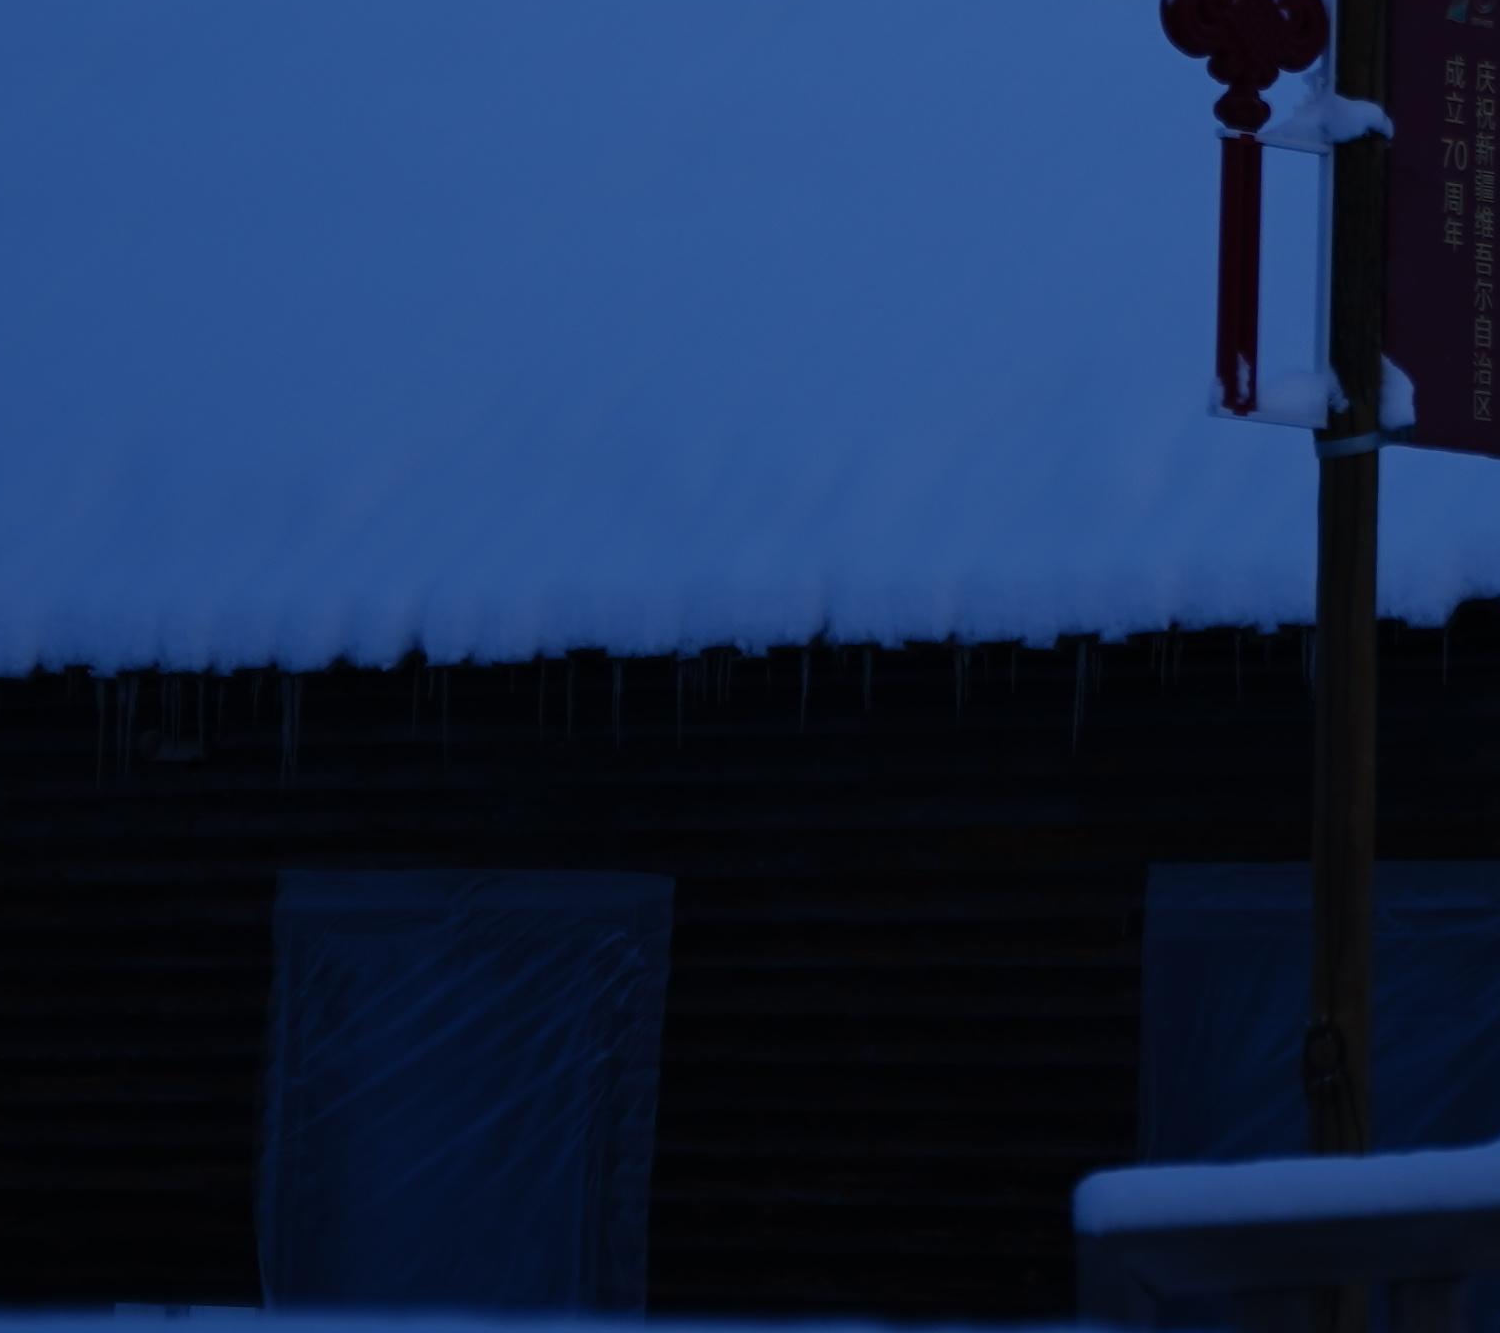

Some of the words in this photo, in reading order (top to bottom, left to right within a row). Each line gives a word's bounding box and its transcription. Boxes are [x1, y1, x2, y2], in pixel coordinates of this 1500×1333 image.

[1474, 60, 1497, 420] 庆祝新疆维吾尔自治区
